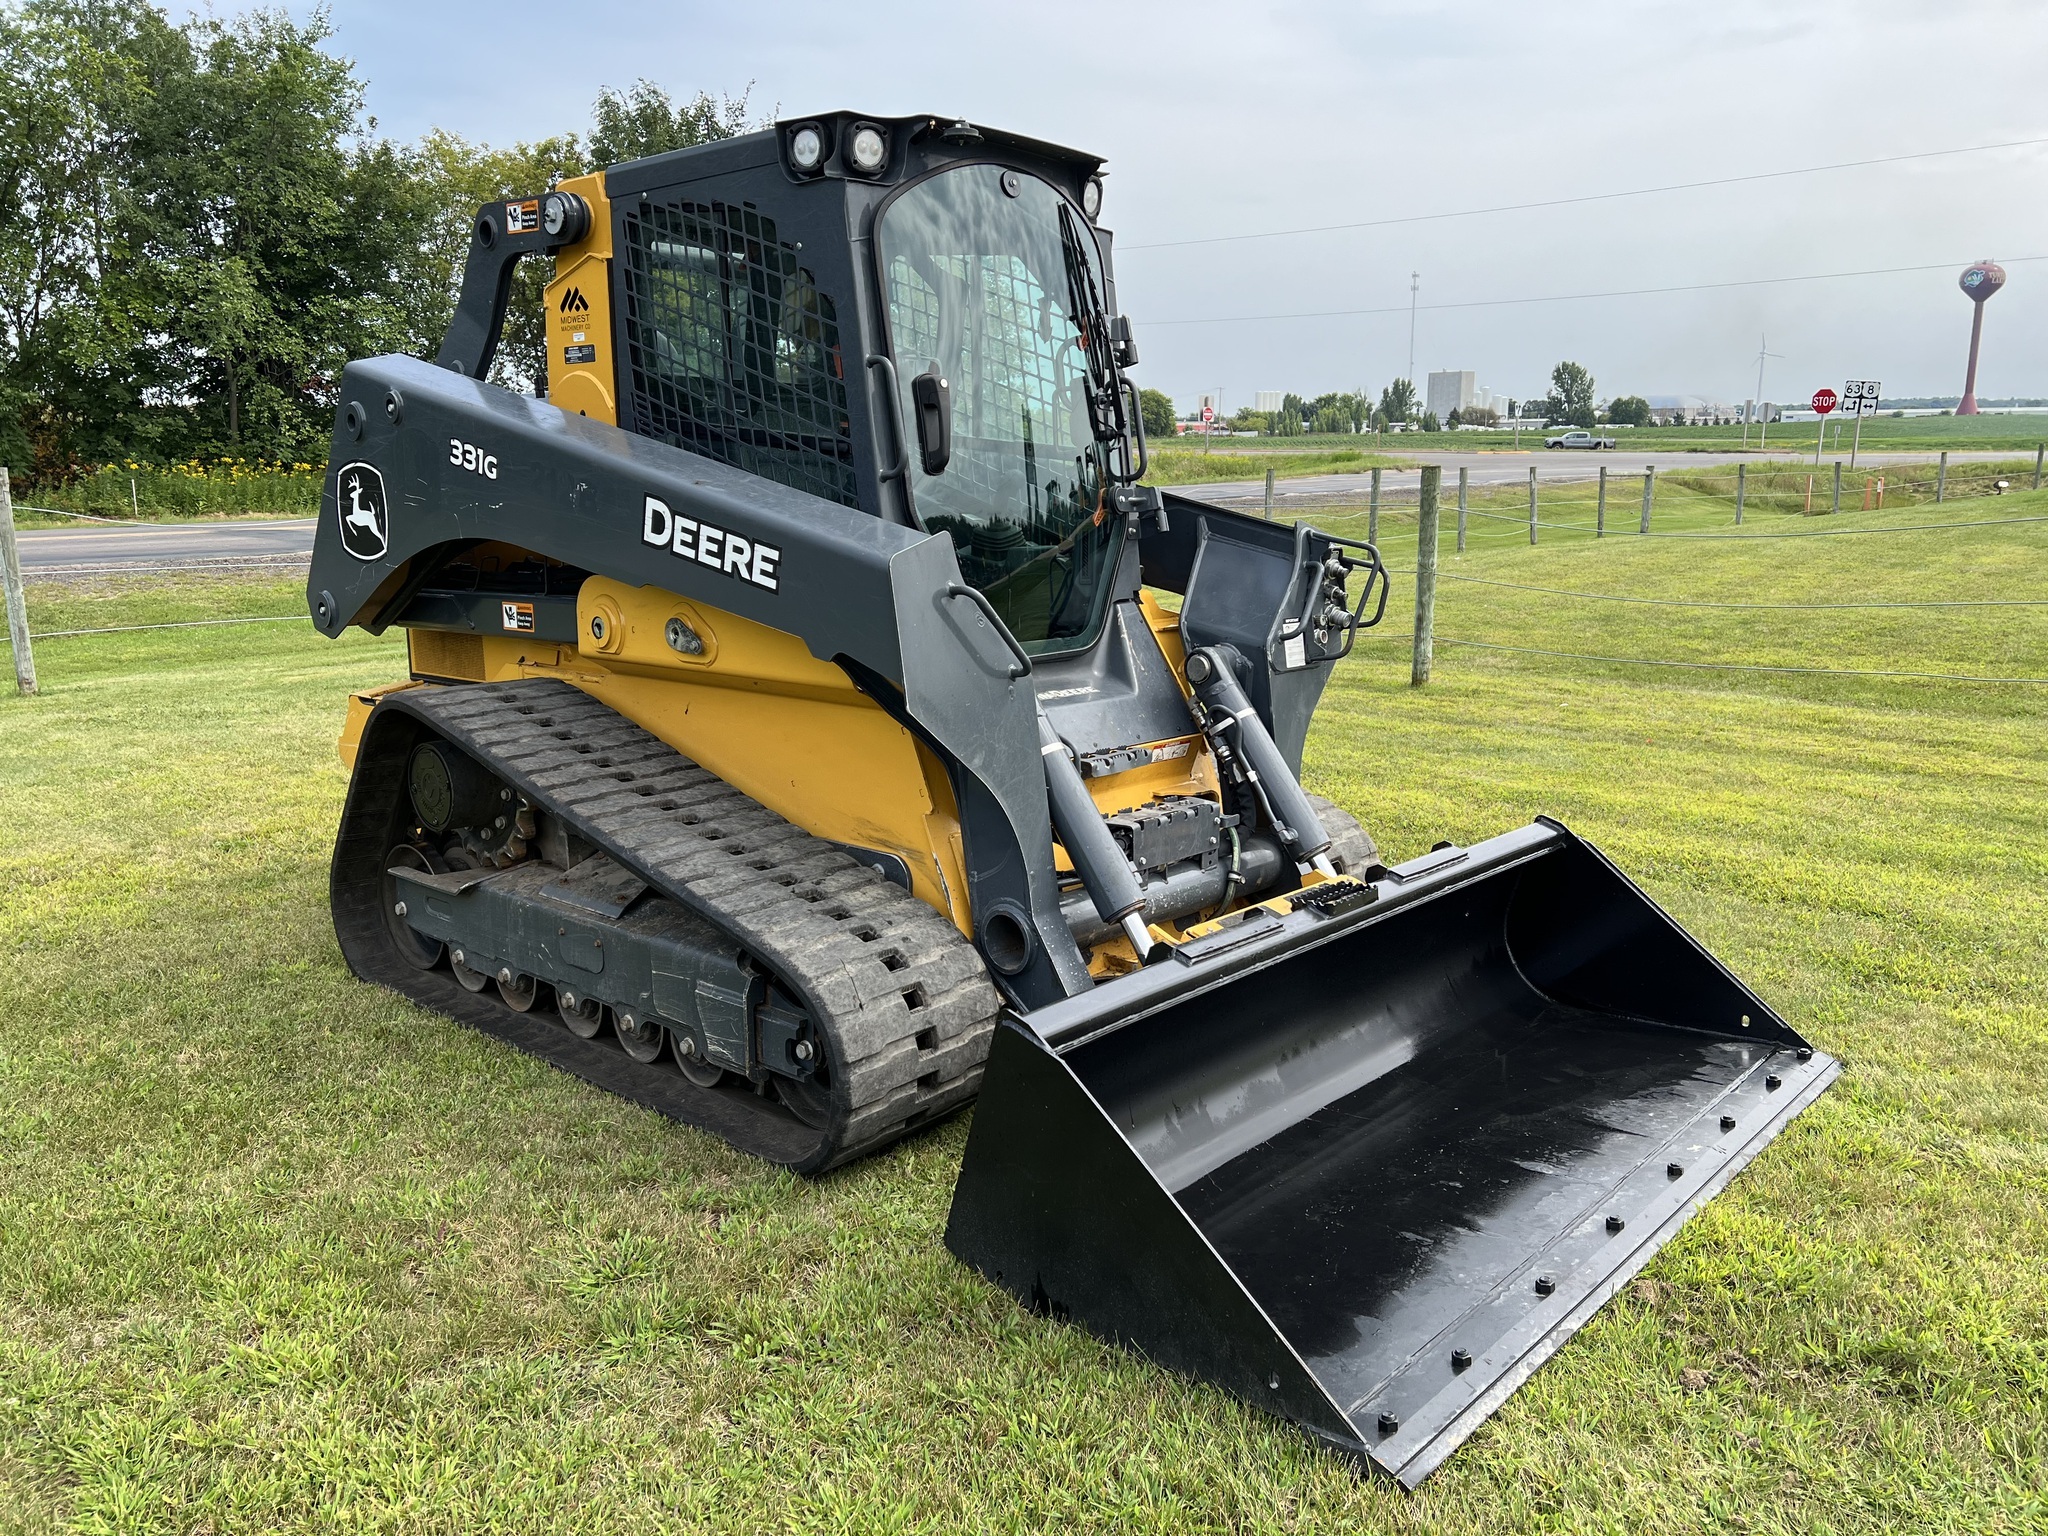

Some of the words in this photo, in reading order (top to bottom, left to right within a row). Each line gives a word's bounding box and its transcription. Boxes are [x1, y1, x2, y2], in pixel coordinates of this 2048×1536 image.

[560, 314, 590, 324] MIDWEST
[1847, 384, 1861, 394] 63
[1867, 385, 1875, 395] 8
[1813, 396, 1836, 407] STOP
[450, 438, 497, 480] 331G
[643, 496, 780, 590] DEERE
